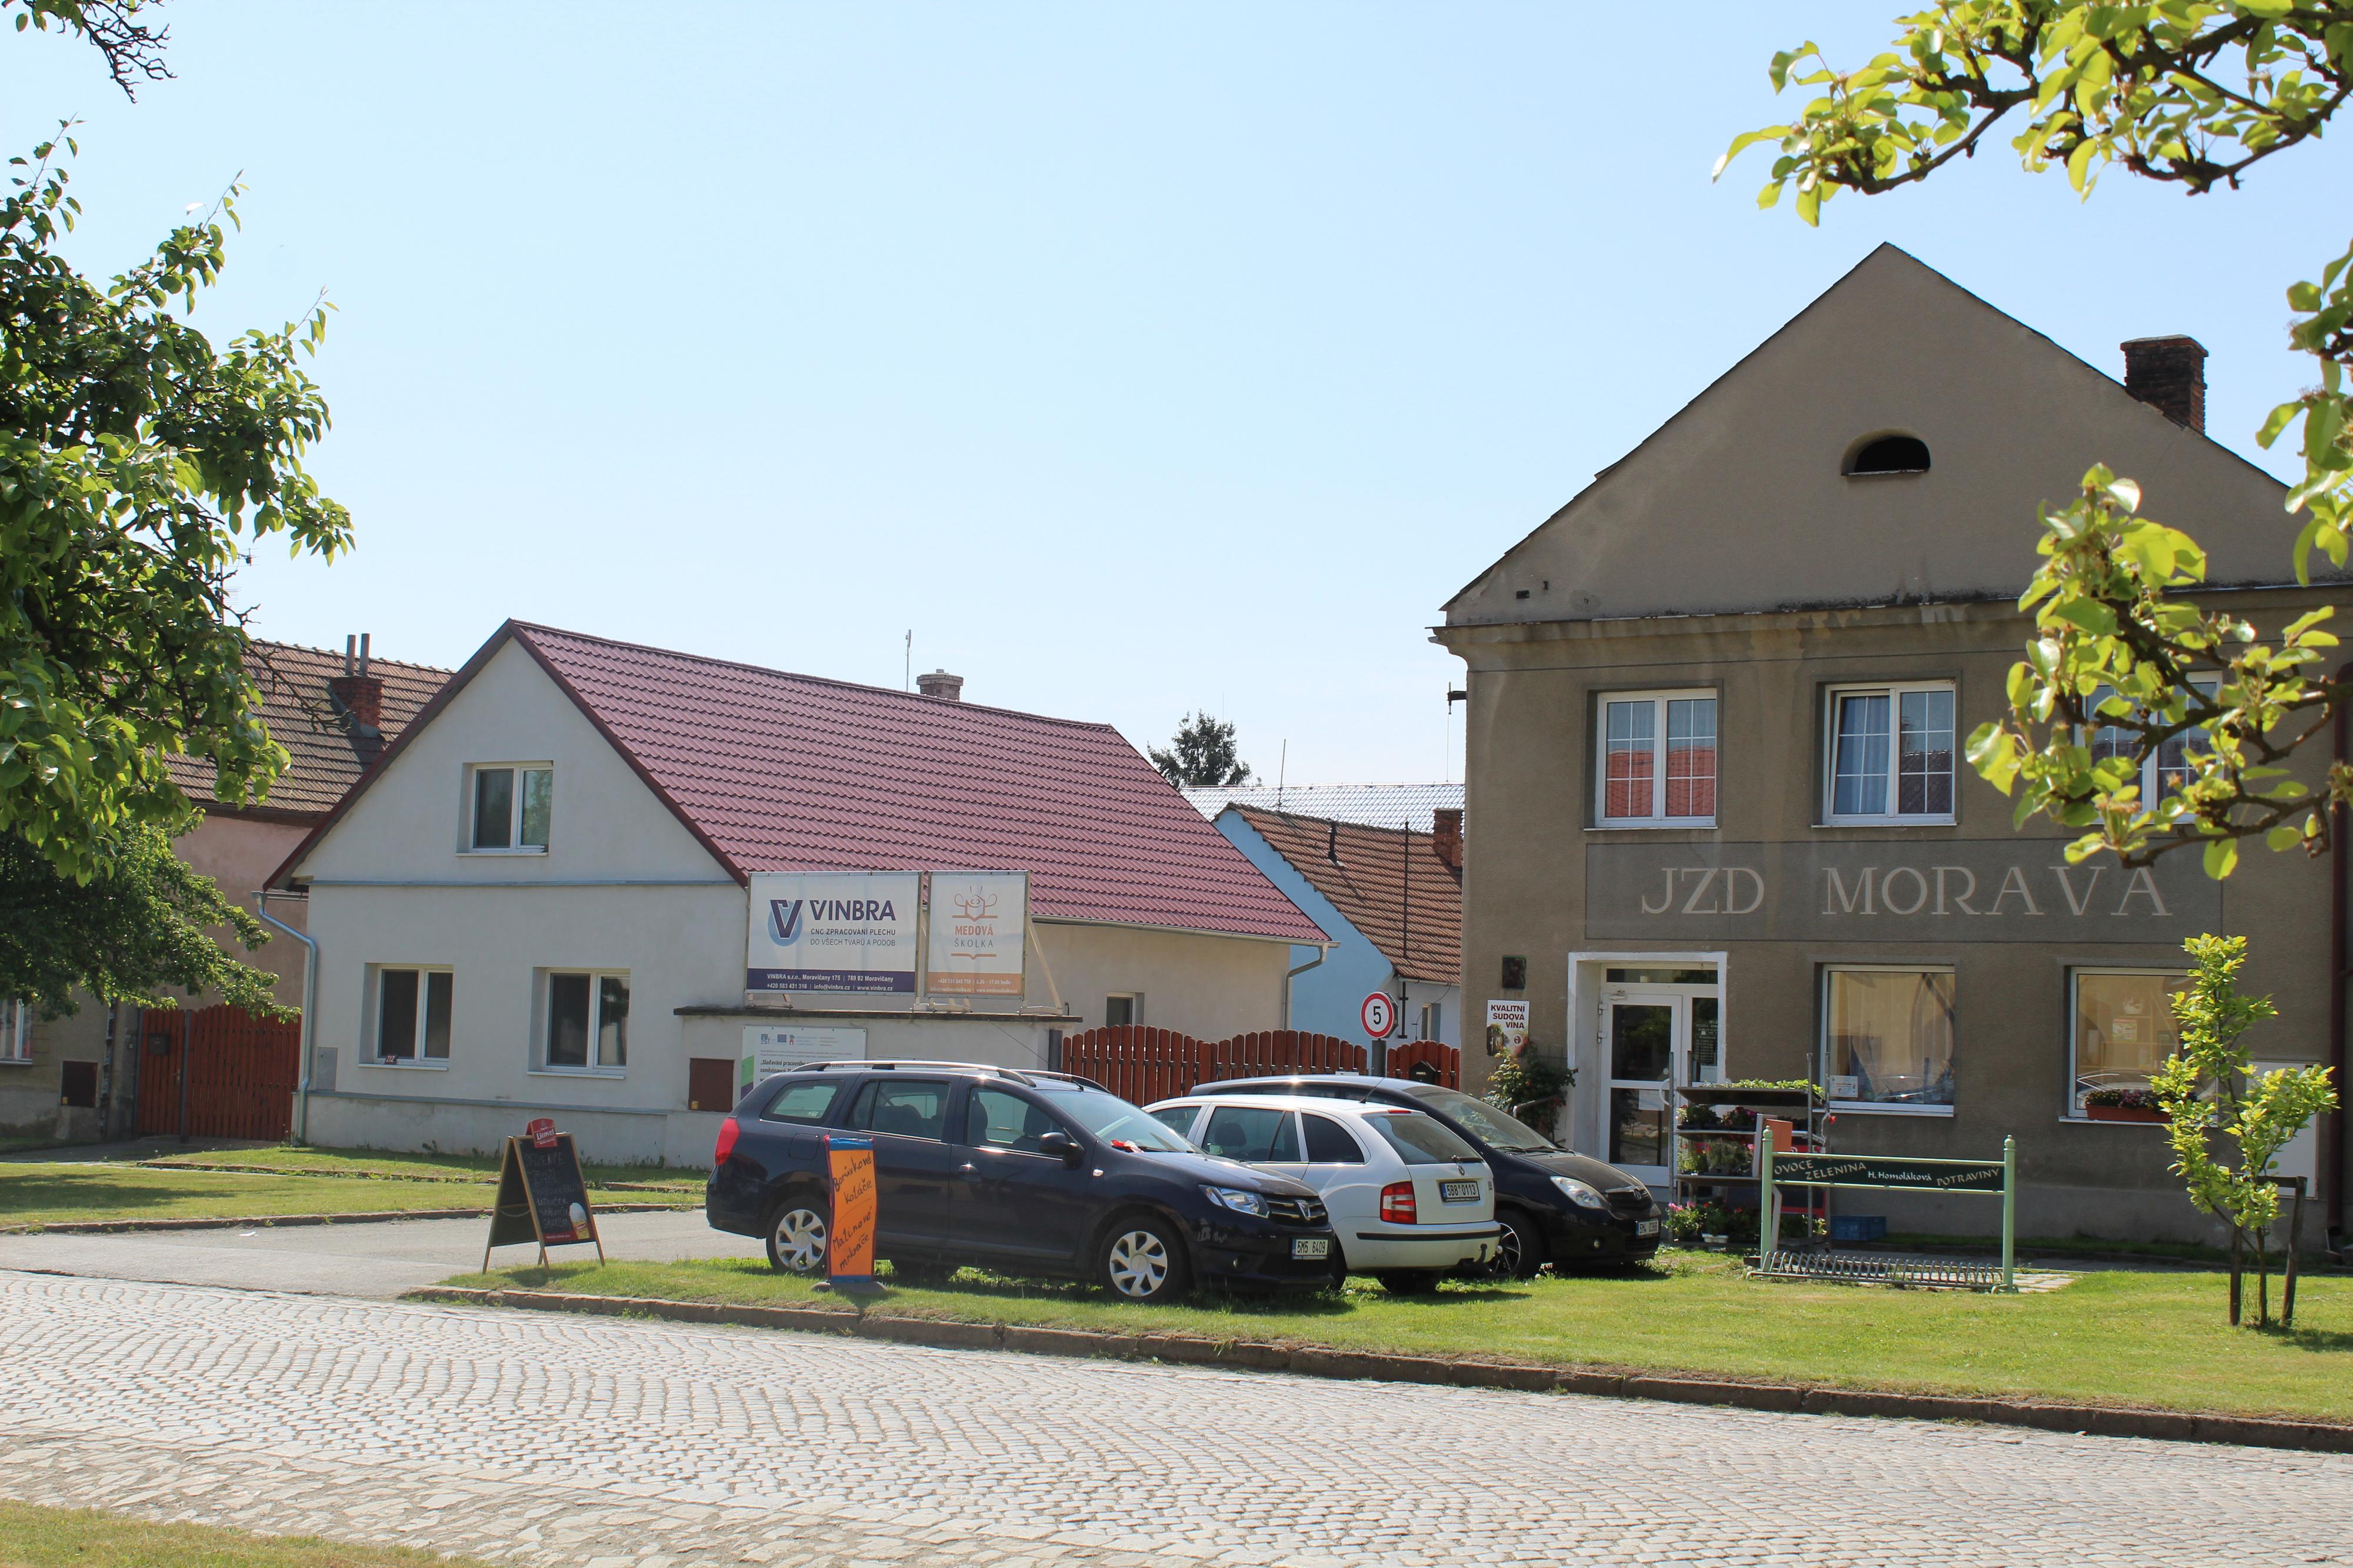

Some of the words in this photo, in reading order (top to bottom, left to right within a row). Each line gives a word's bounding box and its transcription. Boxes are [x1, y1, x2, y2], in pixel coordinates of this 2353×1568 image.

[1641, 867, 1765, 915] JZD
[1821, 865, 2173, 917] MORAVA
[809, 899, 896, 921] VINBRA
[826, 927, 868, 935] ZPRACOVÁNÍ
[955, 923, 994, 936] MEDOVÁ
[821, 938, 842, 946] VŠECH
[955, 938, 994, 948] ŠKOLKA
[1491, 1003, 1525, 1012] KVALITNÍ
[1373, 1006, 1381, 1025] 5
[1774, 1159, 1814, 1175] OVOCE
[1805, 1162, 1867, 1180] ZELENINA
[1878, 1171, 1932, 1181] Homoláková
[1936, 1168, 1999, 1186] POTRAVINY
[1461, 1184, 1476, 1196] 0113
[832, 1206, 872, 1253] Malinové
[1297, 1240, 1308, 1253] 5M5
[1312, 1241, 1326, 1253] 6409
